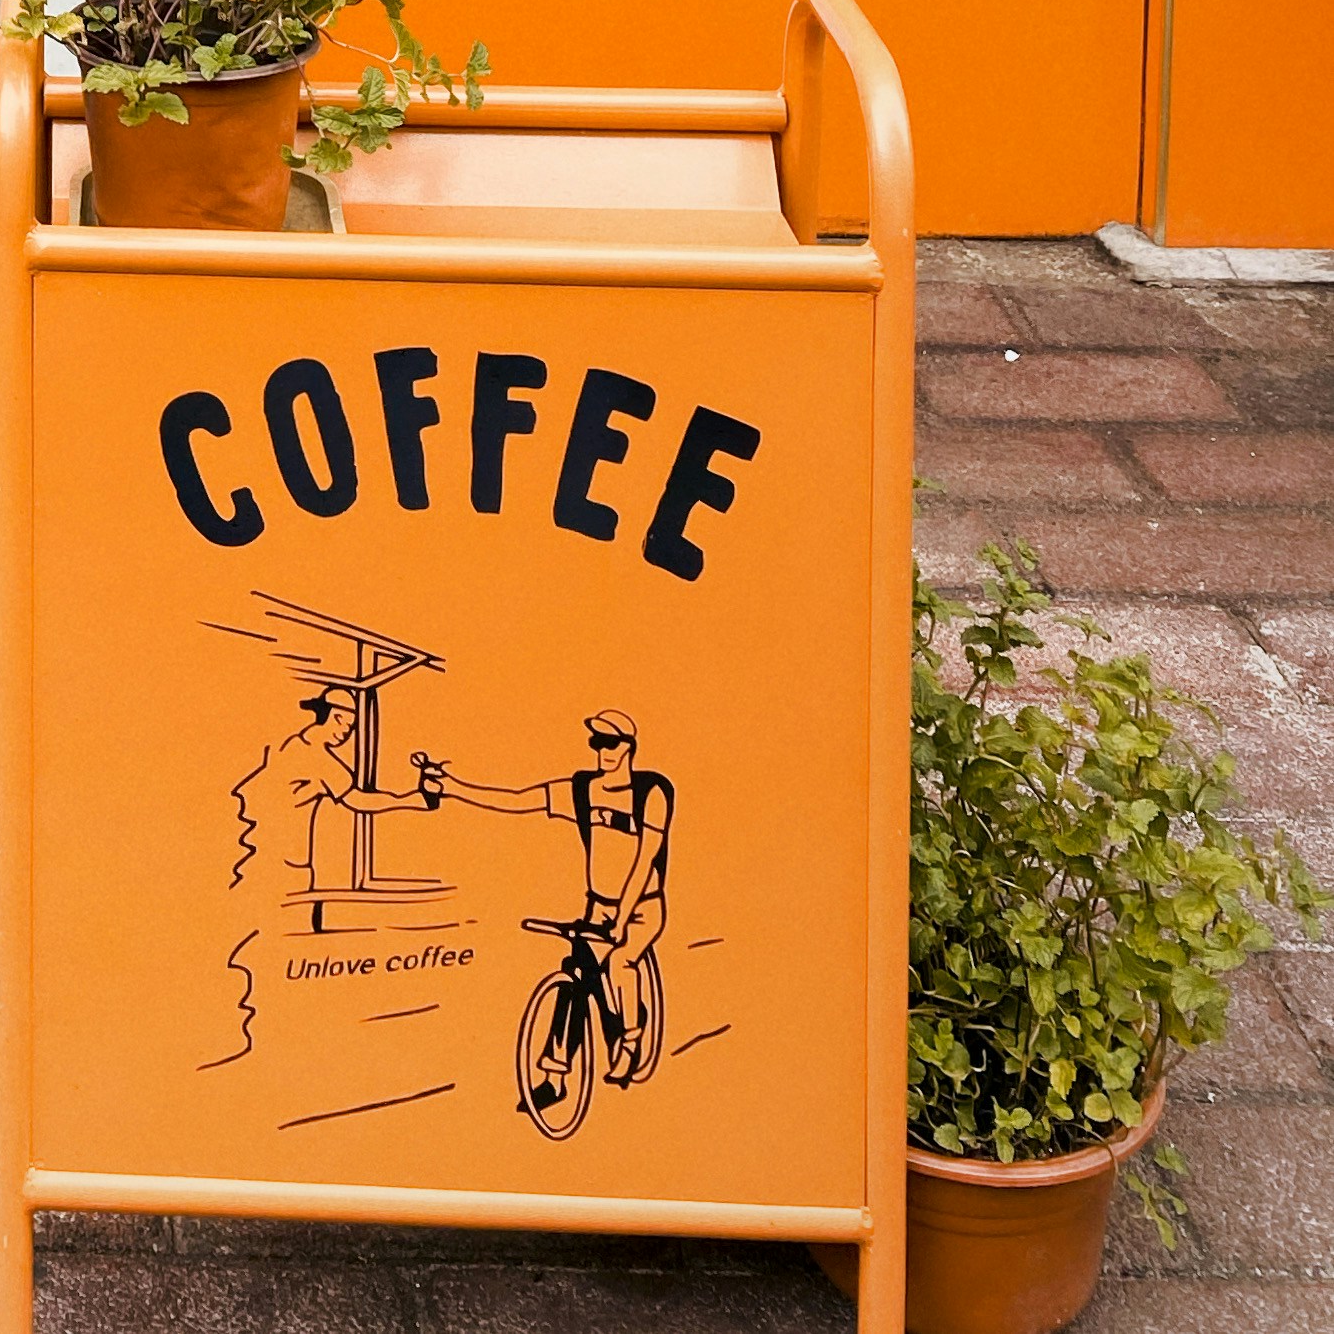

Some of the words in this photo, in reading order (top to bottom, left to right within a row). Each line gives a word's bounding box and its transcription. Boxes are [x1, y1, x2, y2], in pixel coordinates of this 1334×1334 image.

[159, 346, 761, 582] COFFEE
[286, 956, 376, 980] Unlove
[385, 945, 474, 973] coffee
